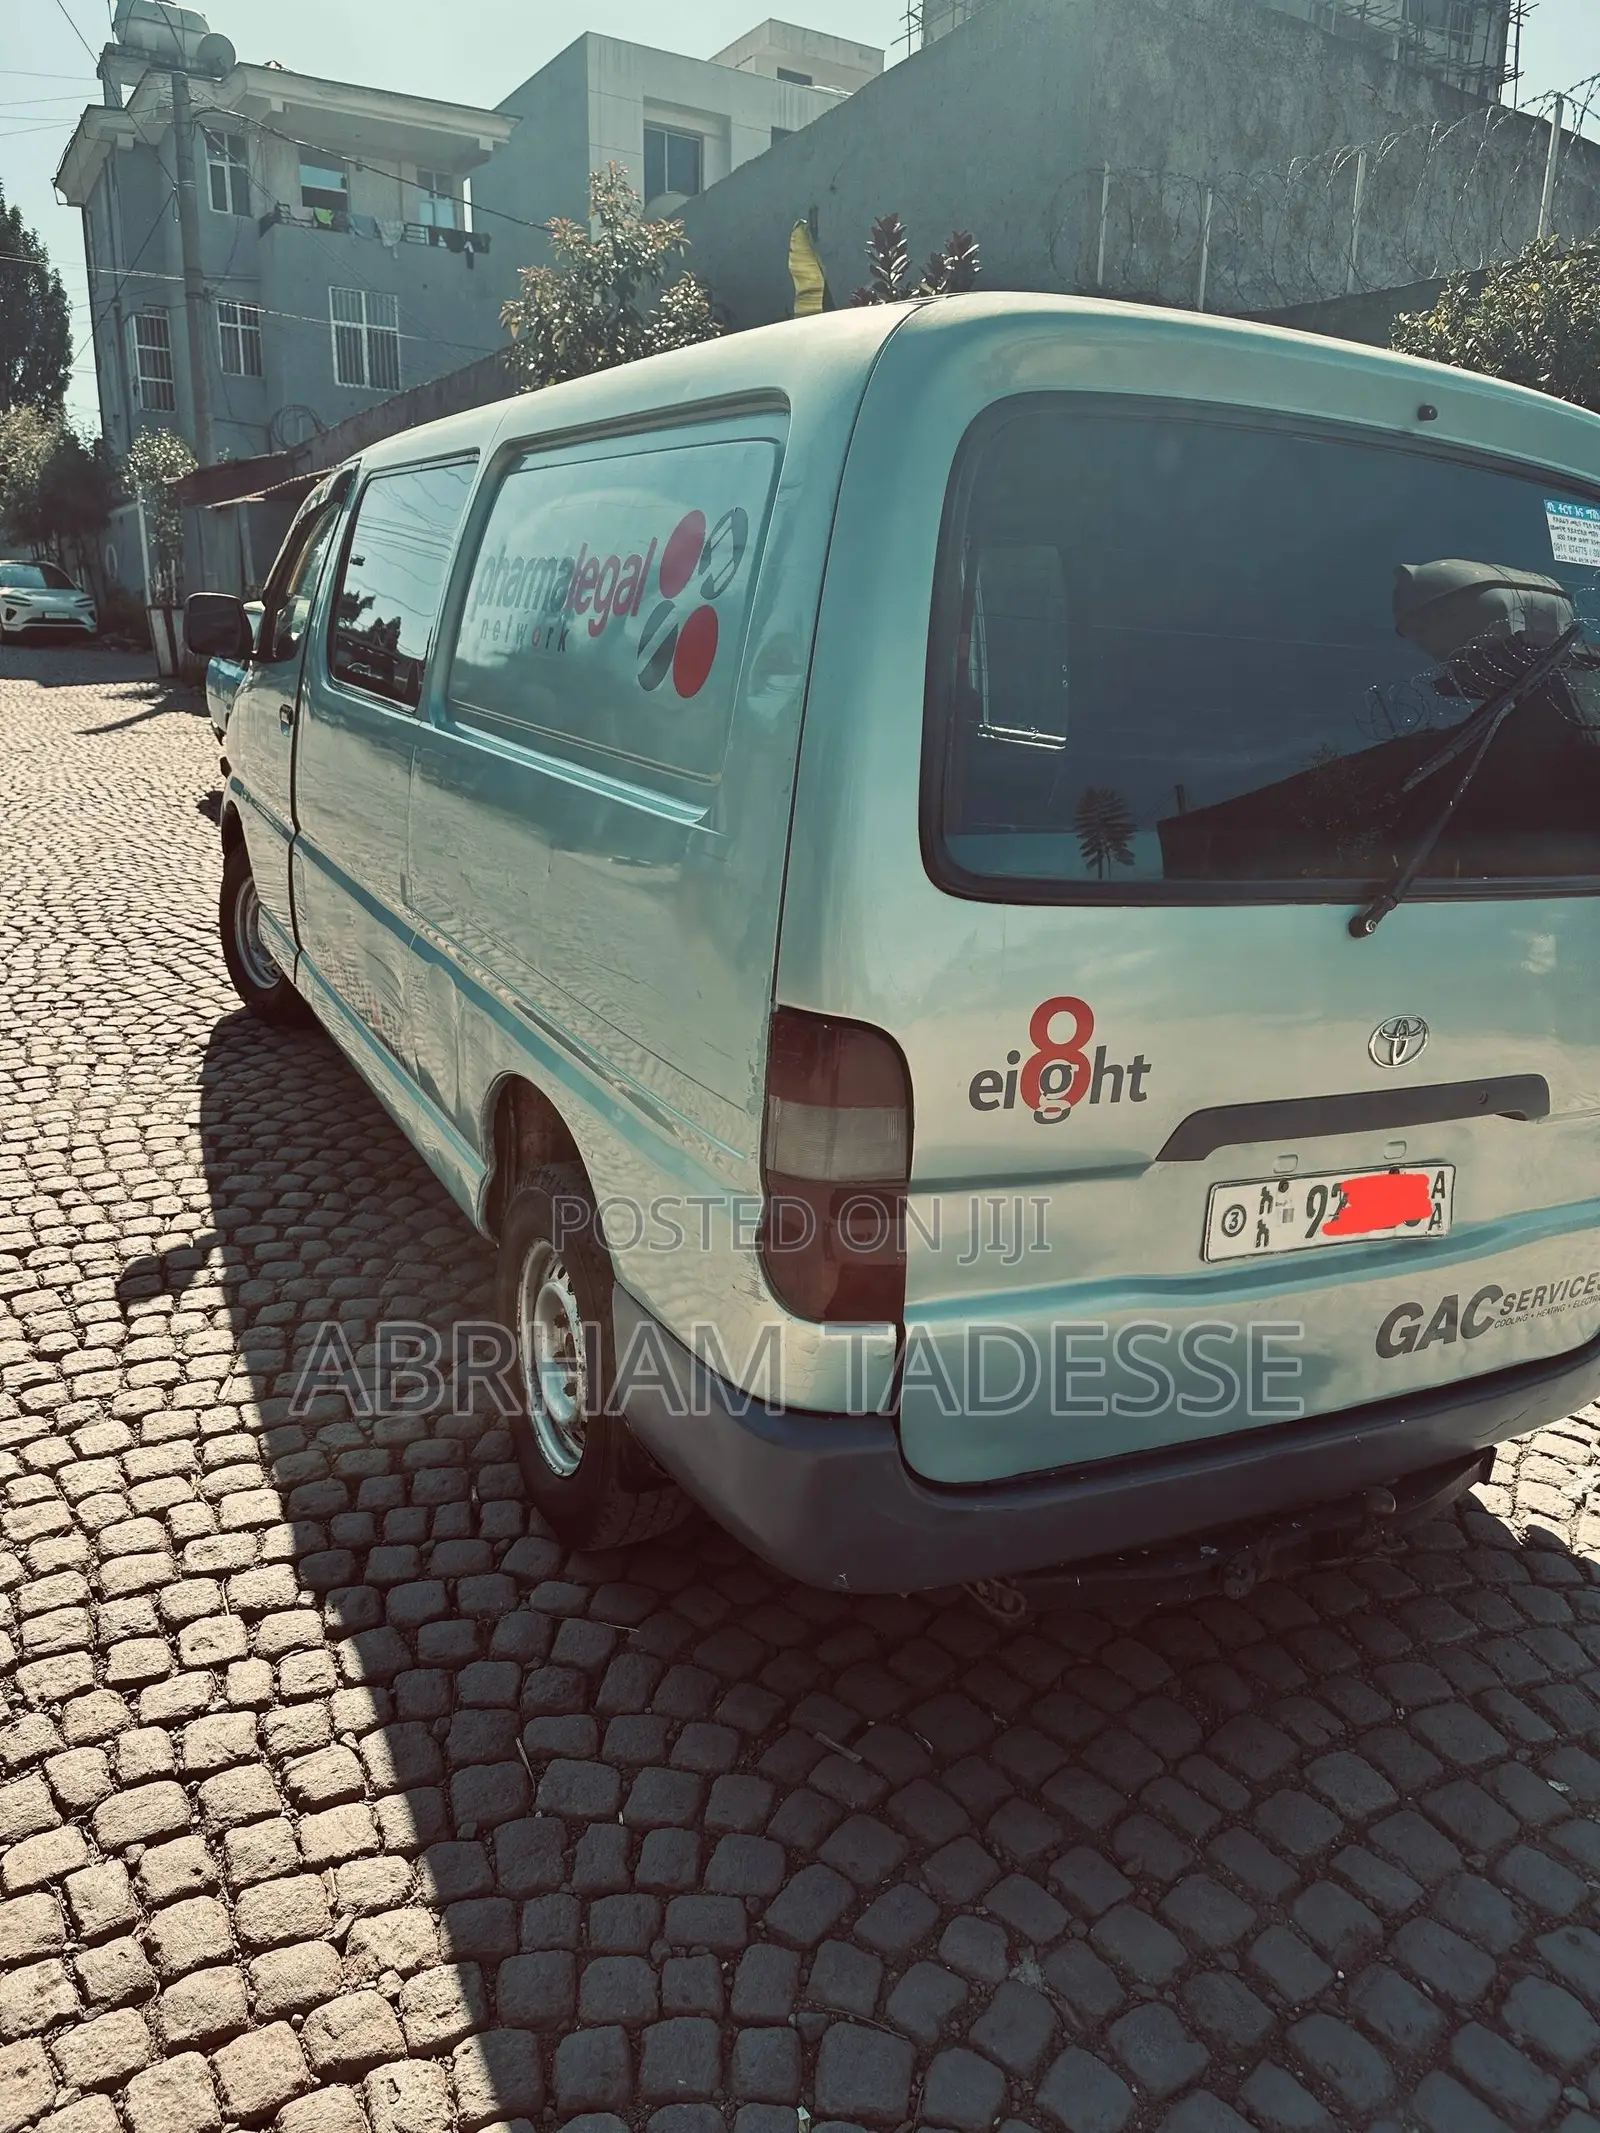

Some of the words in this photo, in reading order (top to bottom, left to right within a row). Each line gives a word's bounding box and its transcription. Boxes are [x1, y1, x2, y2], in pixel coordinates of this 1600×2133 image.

[480, 613, 570, 652] network
[1431, 1171, 1446, 1199] A
[1427, 1202, 1444, 1232] A
[1375, 1284, 1504, 1359] GAC
[1494, 1314, 1529, 1329] COOLING
[1536, 1303, 1566, 1319] HEATING
